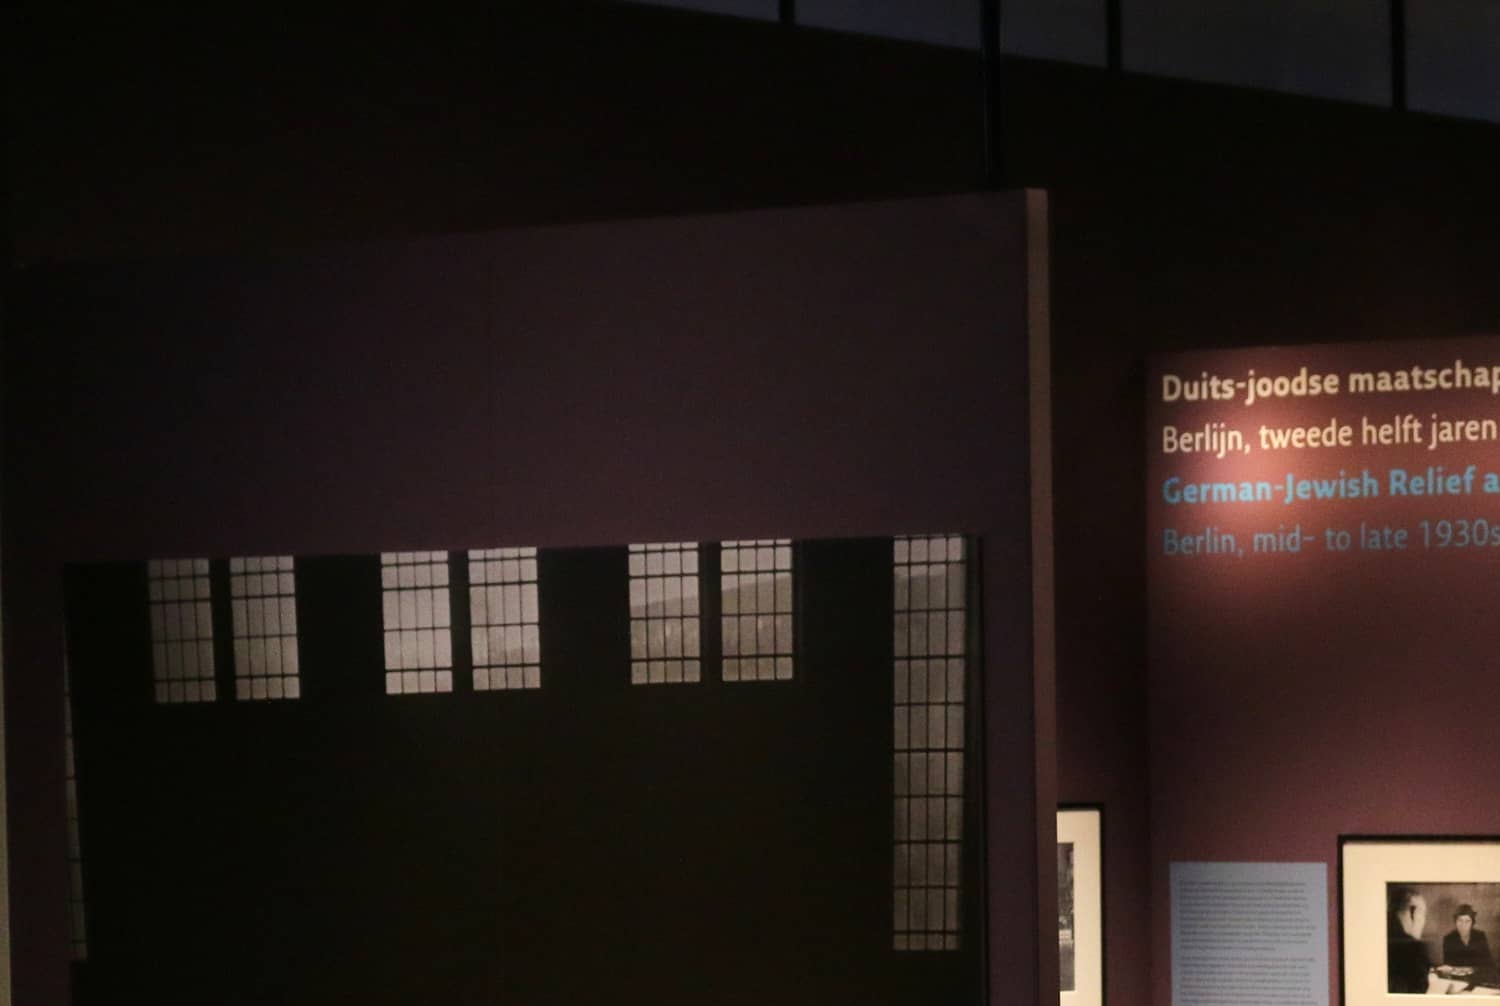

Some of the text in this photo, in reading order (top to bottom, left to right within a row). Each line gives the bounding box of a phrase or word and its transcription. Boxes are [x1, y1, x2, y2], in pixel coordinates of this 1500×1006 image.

[1162, 367, 1339, 406] Duits-joodse
[1162, 422, 1251, 458] Berlijn,
[1259, 417, 1353, 449] tweede
[1362, 414, 1423, 445] helft
[1428, 414, 1497, 450] jaren
[1162, 469, 1379, 505] German-Jewish
[1389, 465, 1476, 497] Relief
[1162, 526, 1244, 557] Berlin,
[1252, 524, 1315, 553] mid-
[1325, 529, 1352, 552] to
[1360, 523, 1408, 551] late
